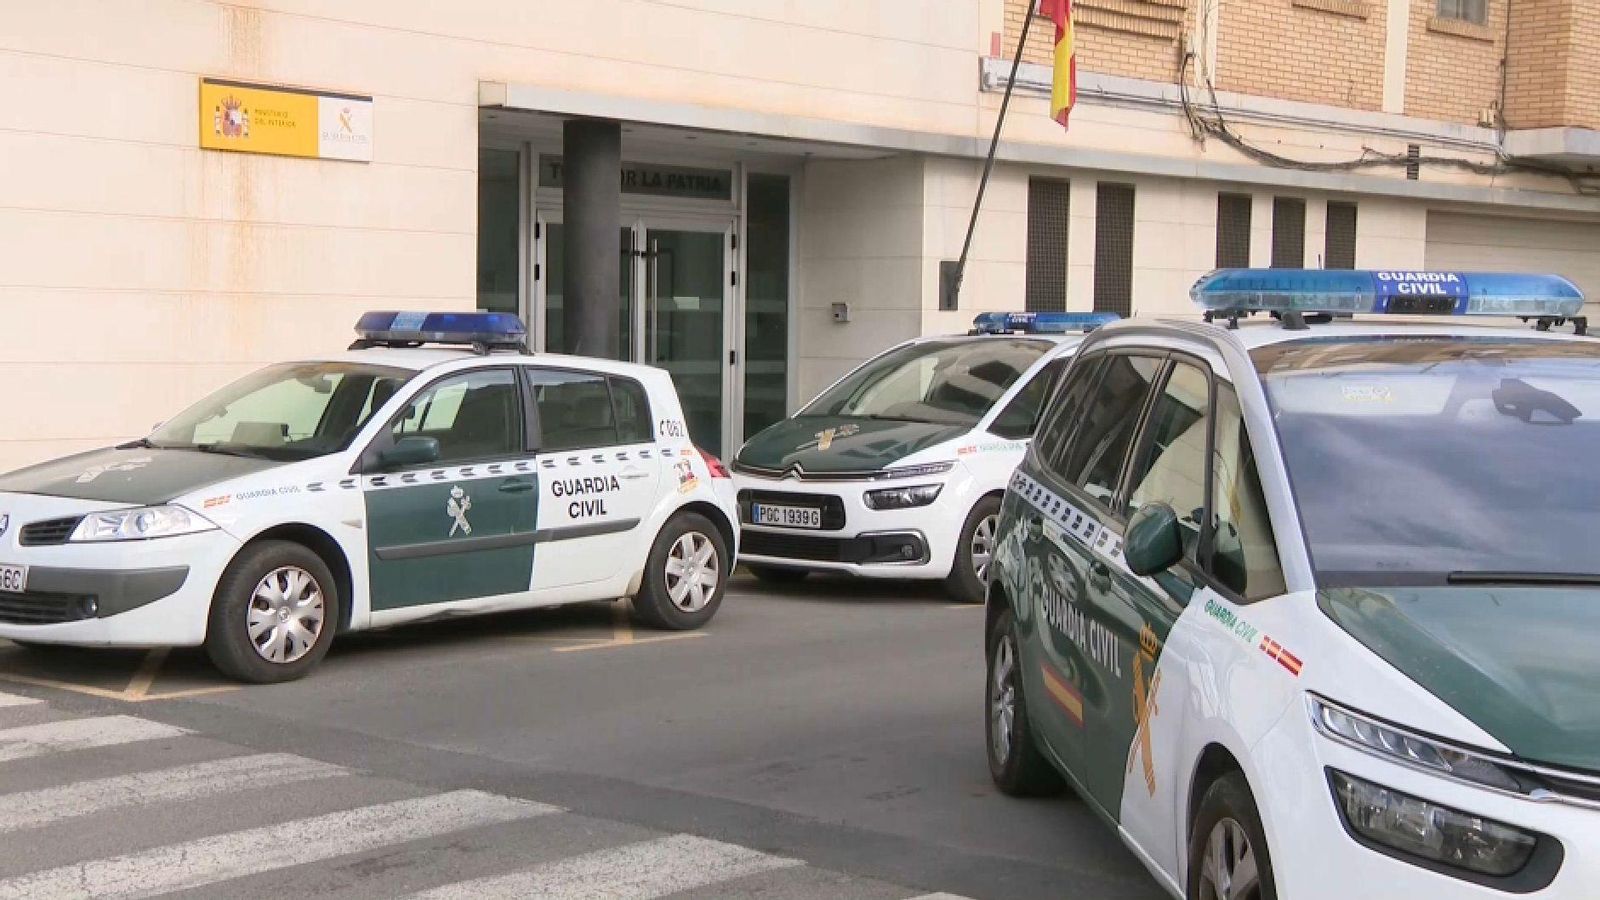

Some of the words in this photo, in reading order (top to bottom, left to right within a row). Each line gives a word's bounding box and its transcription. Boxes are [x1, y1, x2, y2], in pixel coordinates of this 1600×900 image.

[641, 172, 663, 188] LA
[667, 173, 721, 192] PATRIA
[1377, 271, 1460, 282] GUARDIA
[1398, 282, 1447, 294] CIVIL
[552, 475, 621, 497] GUARDIA
[568, 499, 608, 519] CIVIL
[760, 507, 780, 522] PGC
[783, 508, 809, 524] 1939
[811, 510, 819, 525] G
[1041, 582, 1087, 653] GUARDIA
[1090, 619, 1121, 679] CIVIL
[1204, 599, 1238, 630] GUARDIA
[1234, 621, 1258, 643] CIVIL
